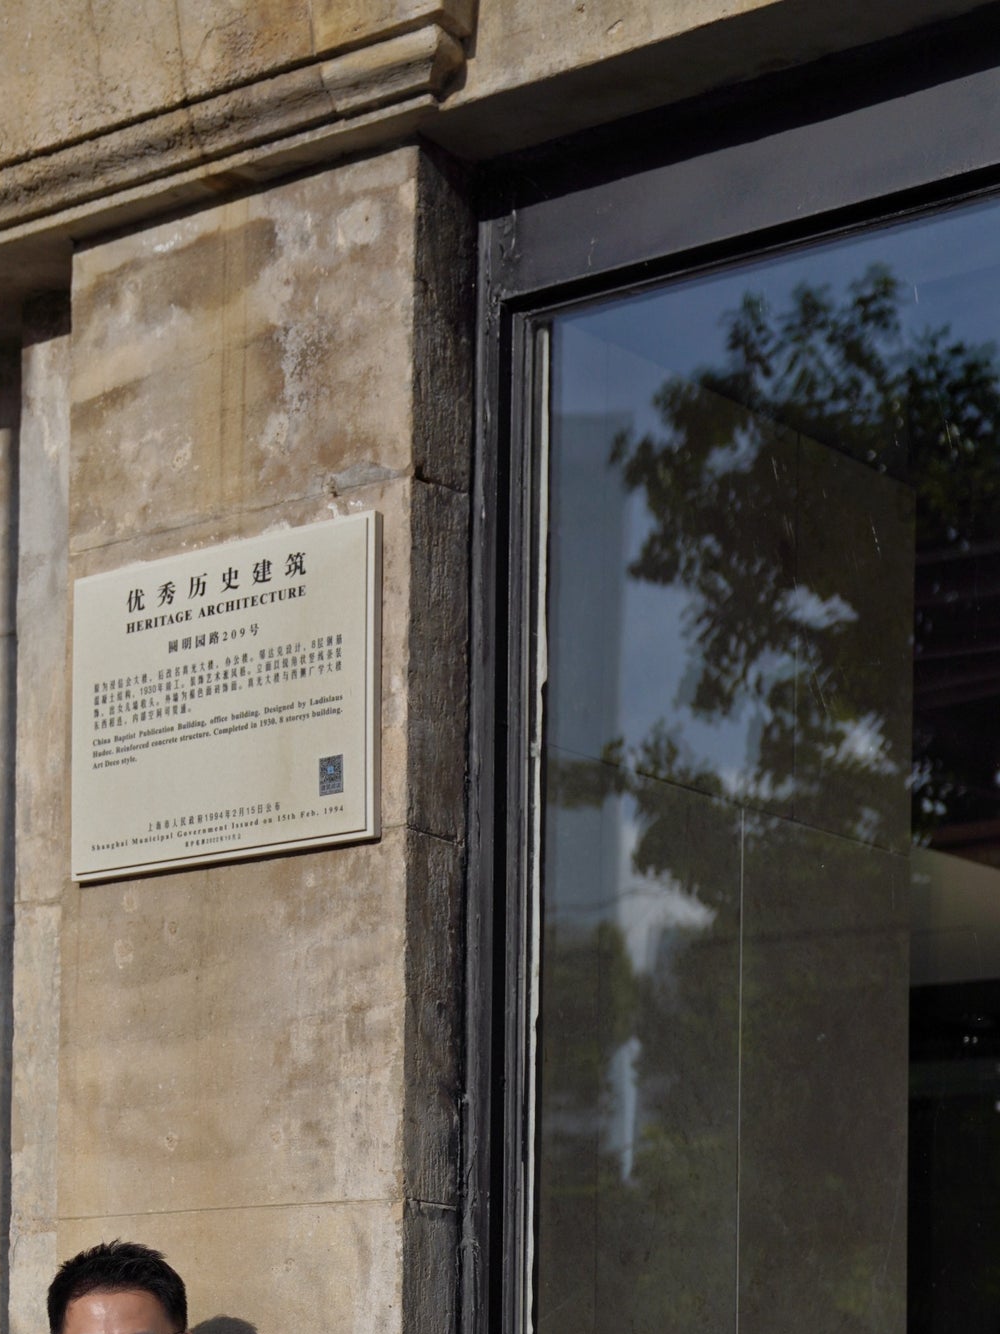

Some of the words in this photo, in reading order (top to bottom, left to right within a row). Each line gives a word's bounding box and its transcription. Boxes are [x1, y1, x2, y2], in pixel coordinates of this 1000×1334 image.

[125, 551, 306, 613] 优秀历史建筑
[125, 608, 192, 634] HERITAGE
[197, 584, 306, 618] ARCHITECTURE
[91, 737, 111, 747] China
[113, 732, 136, 743] Baptist
[138, 725, 174, 738] Publication
[209, 714, 228, 724] office
[263, 701, 294, 714] Designed
[297, 700, 306, 709] by
[309, 694, 343, 706] Ladislaus
[115, 740, 149, 754] Reinforced
[150, 736, 178, 747] concrete
[179, 730, 211, 742] structure.
[212, 721, 248, 735] Completed
[250, 721, 257, 729] in
[278, 715, 284, 724] 8
[285, 712, 310, 723] storeys
[311, 706, 343, 718] building.
[91, 761, 103, 769] Art
[104, 759, 120, 767] Deco
[120, 755, 137, 765] style.
[91, 839, 128, 851] Shanghai
[131, 831, 173, 845] Municipal
[176, 823, 227, 838] Government
[231, 817, 258, 829] Issued
[277, 812, 295, 822] 15th
[299, 809, 319, 818] Feb.
[323, 804, 343, 814] 1994
